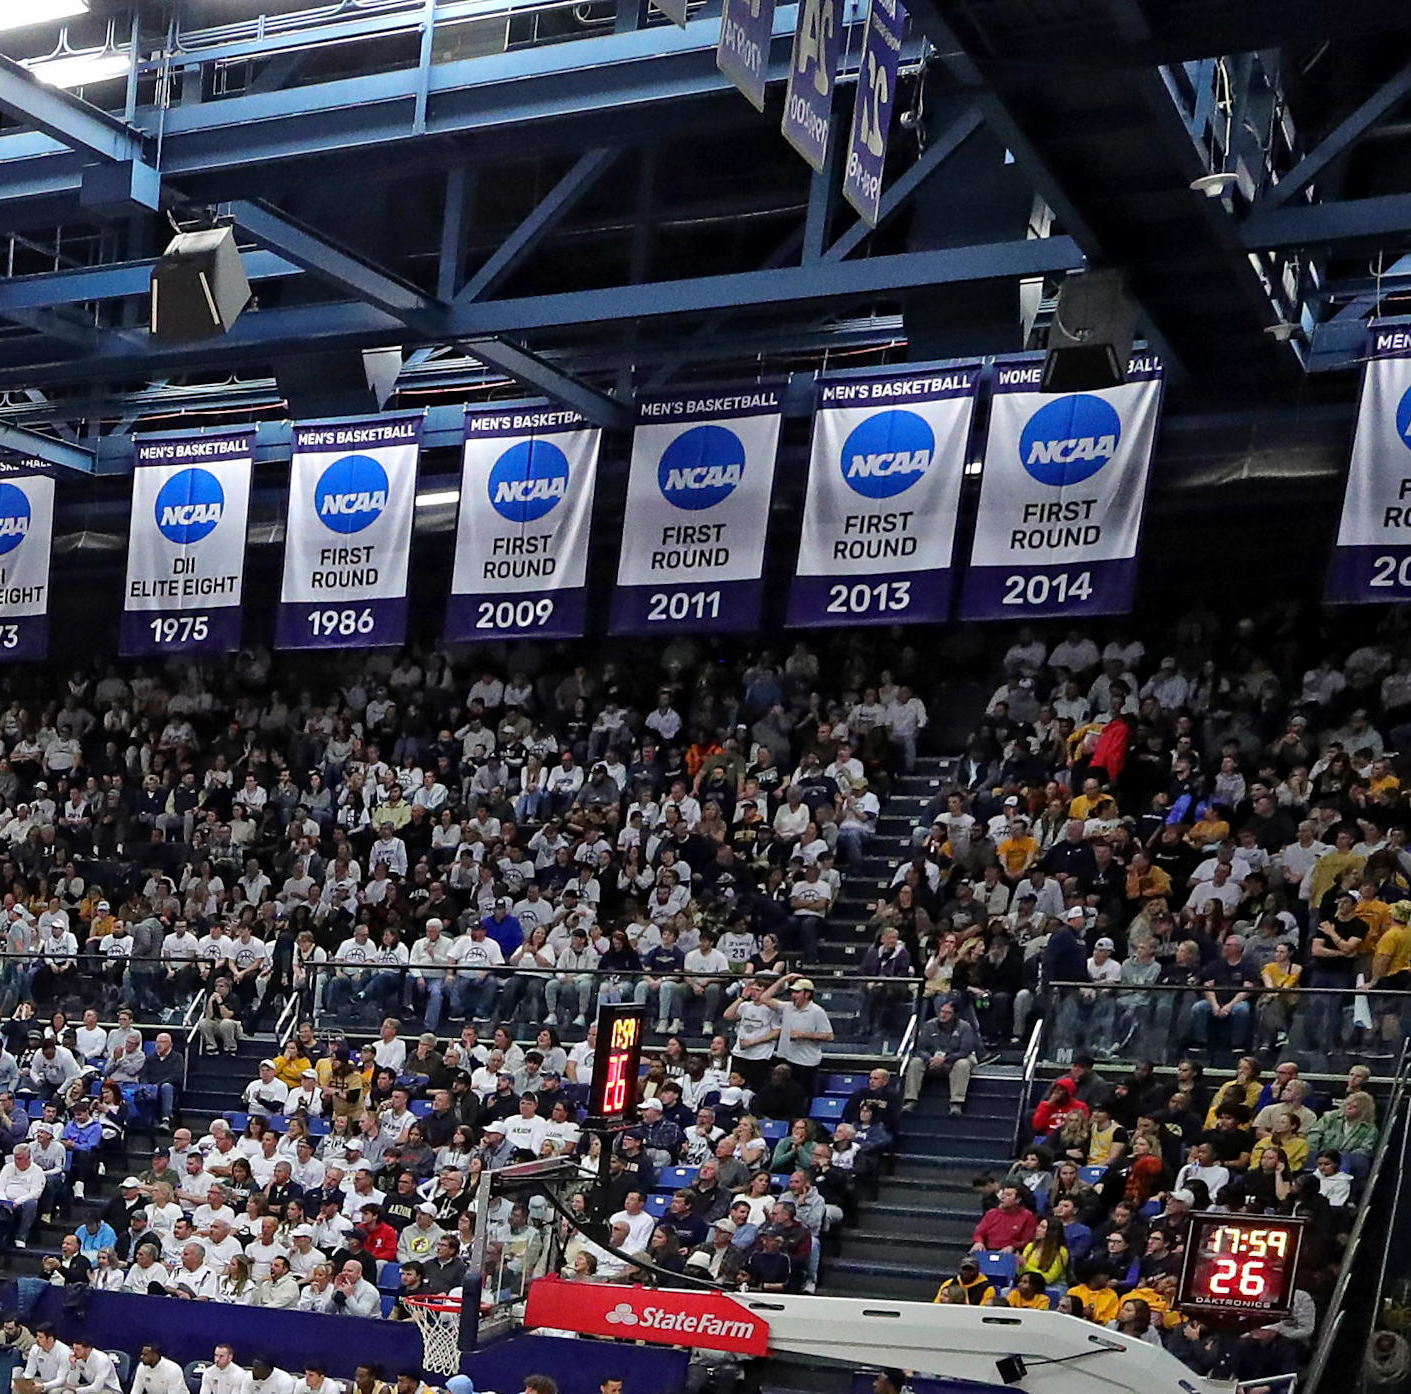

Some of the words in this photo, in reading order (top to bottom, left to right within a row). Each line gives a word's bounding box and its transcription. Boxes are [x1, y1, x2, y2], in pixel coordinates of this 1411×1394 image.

[822, 384, 870, 401] MEN'S
[872, 374, 971, 399] BASKETBALL
[641, 401, 683, 417] MEN'S
[686, 392, 779, 414] BASKETBALL
[298, 432, 335, 446] MEN'S
[336, 424, 416, 445] BASKETBALL
[471, 416, 511, 432] MEN'S
[139, 447, 174, 459] MEN'S
[175, 439, 249, 457] BASKETBALL
[1027, 434, 1118, 465] NCAA
[846, 449, 931, 479] NCAA
[664, 463, 742, 491] NCAA
[321, 490, 386, 515] NCAA
[494, 477, 568, 504] NCAA
[160, 503, 222, 526] NCAA
[844, 511, 914, 534] FIRST
[1023, 499, 1098, 524] FIRST
[492, 534, 552, 556] FIRST
[661, 524, 727, 546] FIRST
[1010, 524, 1101, 551] ROUND
[320, 546, 375, 565] FIRST
[651, 548, 730, 570] ROUND
[833, 536, 918, 560] ROUND
[311, 568, 378, 589] ROUND
[483, 558, 556, 580] ROUND
[130, 578, 179, 597] ELITE
[182, 576, 238, 594] EIGHT
[827, 581, 911, 613] 2013
[1001, 570, 1093, 606] 2014
[475, 598, 554, 629] 2009
[647, 590, 721, 621] 2011
[150, 616, 209, 643] 1975
[308, 608, 375, 636] 1986
[610, 1018, 635, 1050] 17:59
[603, 1054, 628, 1113] 26
[1214, 1228, 1288, 1258] 17:59
[1210, 1259, 1265, 1296] 26
[1196, 1296, 1271, 1309] DAKTRONICS
